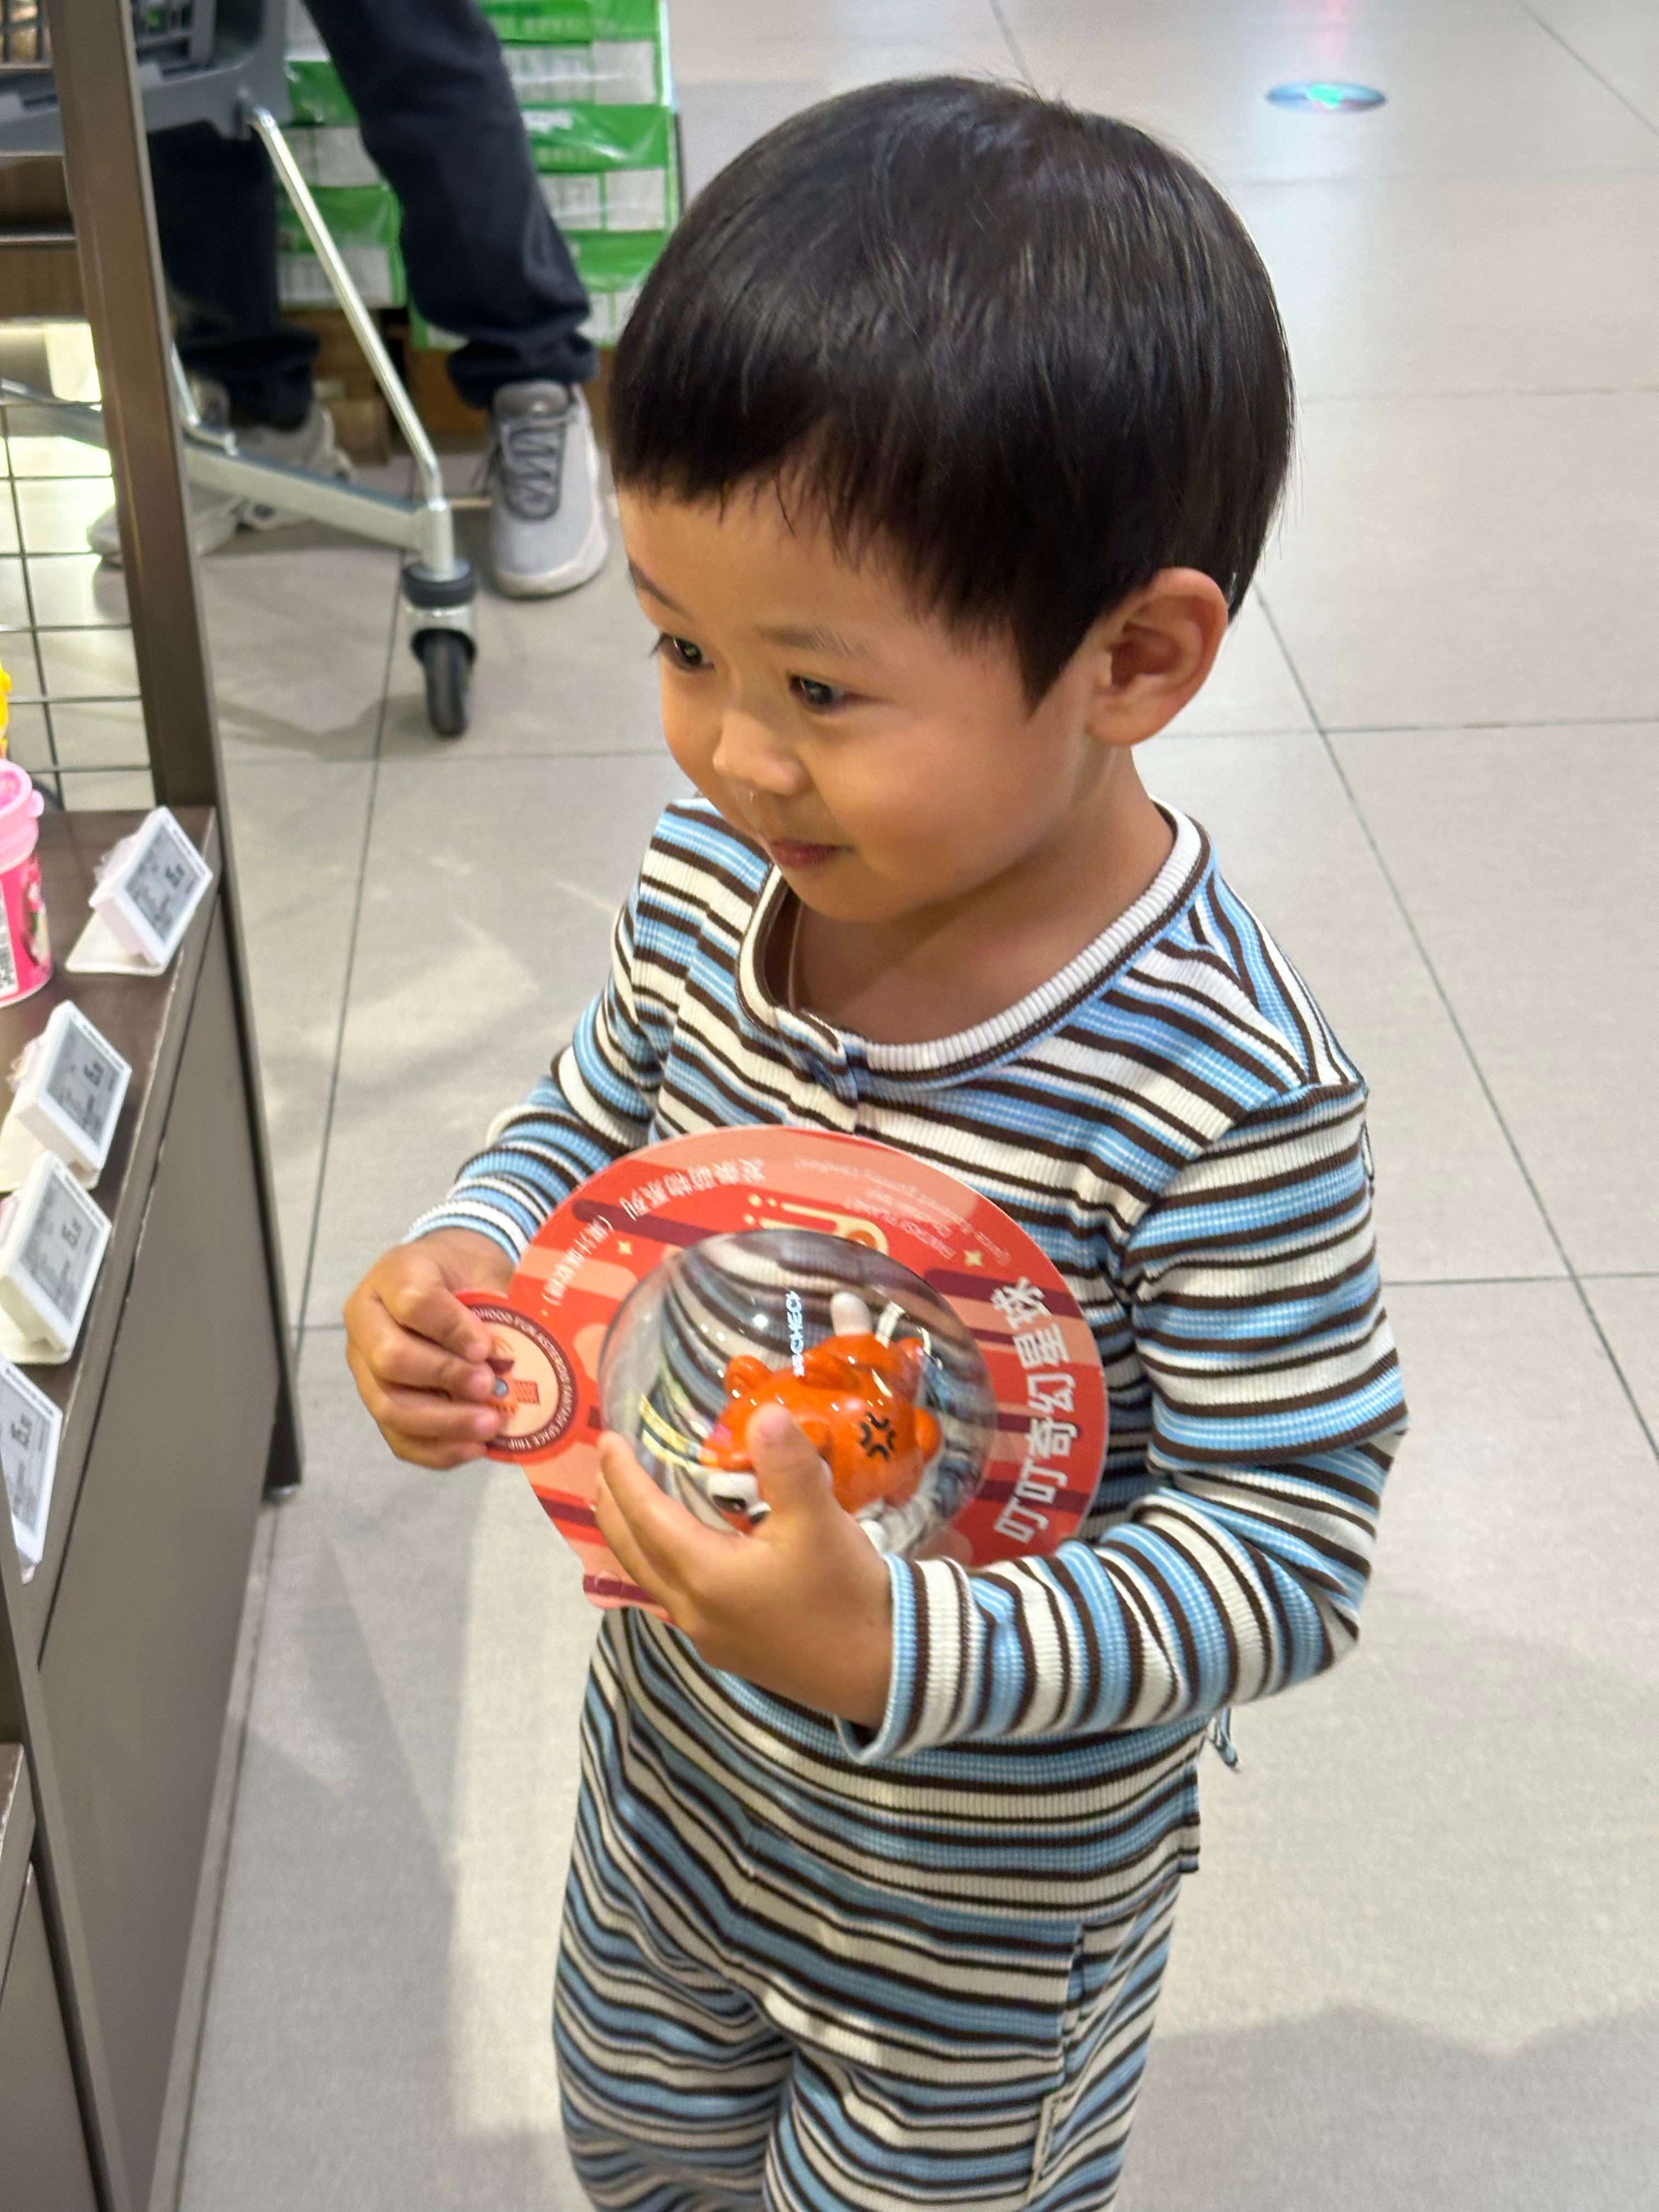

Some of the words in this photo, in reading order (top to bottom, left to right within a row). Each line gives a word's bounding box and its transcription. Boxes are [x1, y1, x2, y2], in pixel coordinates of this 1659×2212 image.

[507, 1437, 532, 1451] TRIP
[990, 1276, 1078, 1544] 叮叮奇幻星球
